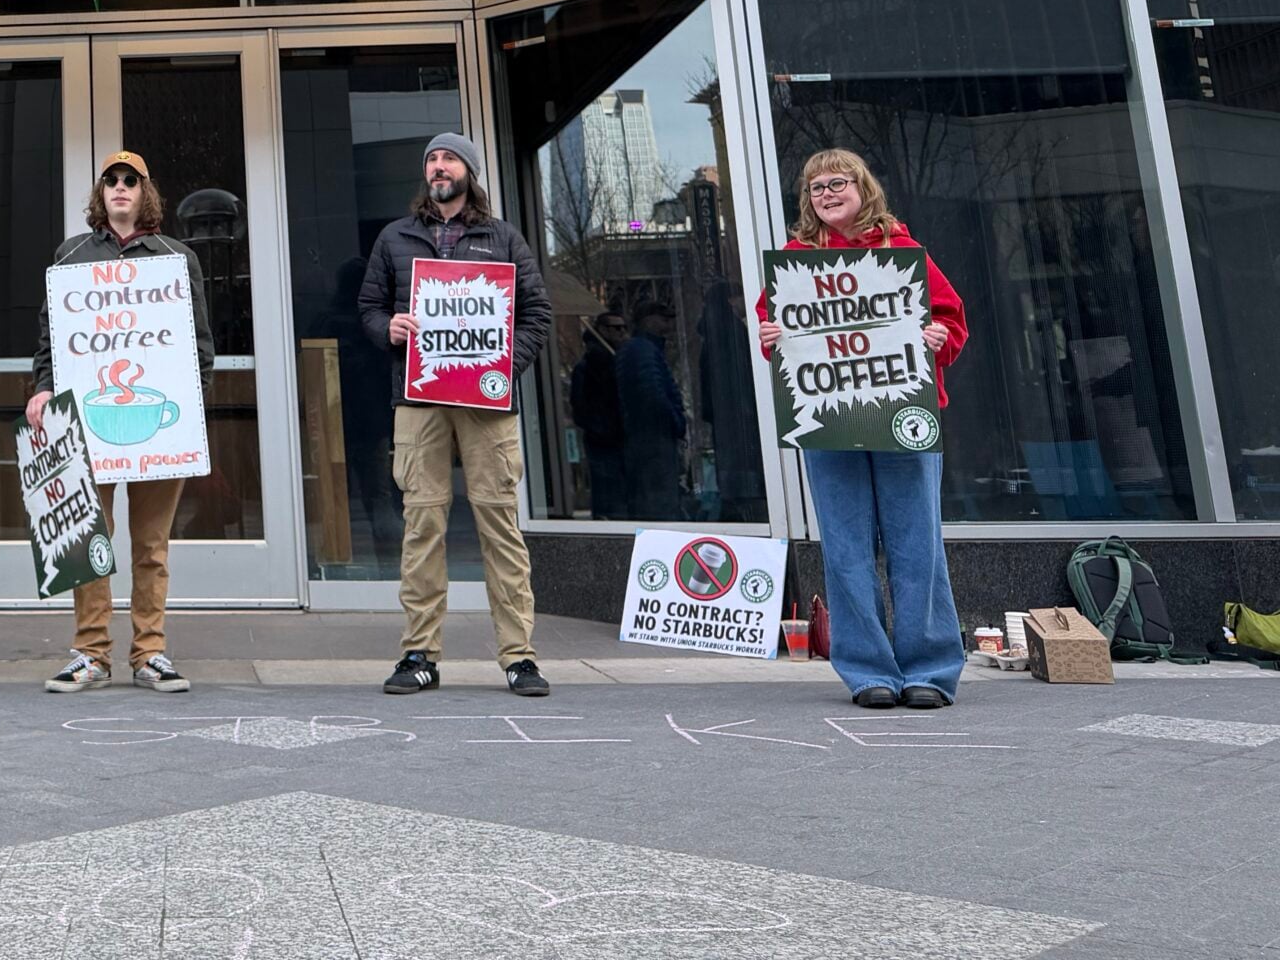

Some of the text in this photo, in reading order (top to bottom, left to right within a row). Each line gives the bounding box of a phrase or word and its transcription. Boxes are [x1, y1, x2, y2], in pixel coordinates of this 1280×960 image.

[92, 262, 138, 286] NO
[814, 272, 859, 299] NO
[448, 287, 471, 297] OUR
[424, 296, 495, 317] UNION
[781, 285, 913, 330] CONTRACT?
[94, 310, 138, 333] NO
[457, 318, 467, 328] IS
[422, 328, 504, 353] STRONG!
[825, 332, 870, 359] NO
[796, 343, 920, 396] COFFEE!
[897, 408, 933, 422] STARBUCKS
[29, 426, 48, 455] NO
[22, 425, 79, 490] CONTRACT?
[139, 451, 203, 473] power
[43, 478, 66, 507] NO
[38, 478, 95, 546] COFFEE!
[637, 597, 764, 626] NO CONTRACT?
[633, 614, 764, 644] NO STARBUCKS!
[639, 632, 659, 642] STAND
[659, 635, 676, 645] WITH
[677, 638, 697, 648] UNION
[697, 640, 734, 652] STARBUCKS
[735, 645, 767, 656] WORKERS
[60, 713, 1018, 750] STRIKE
